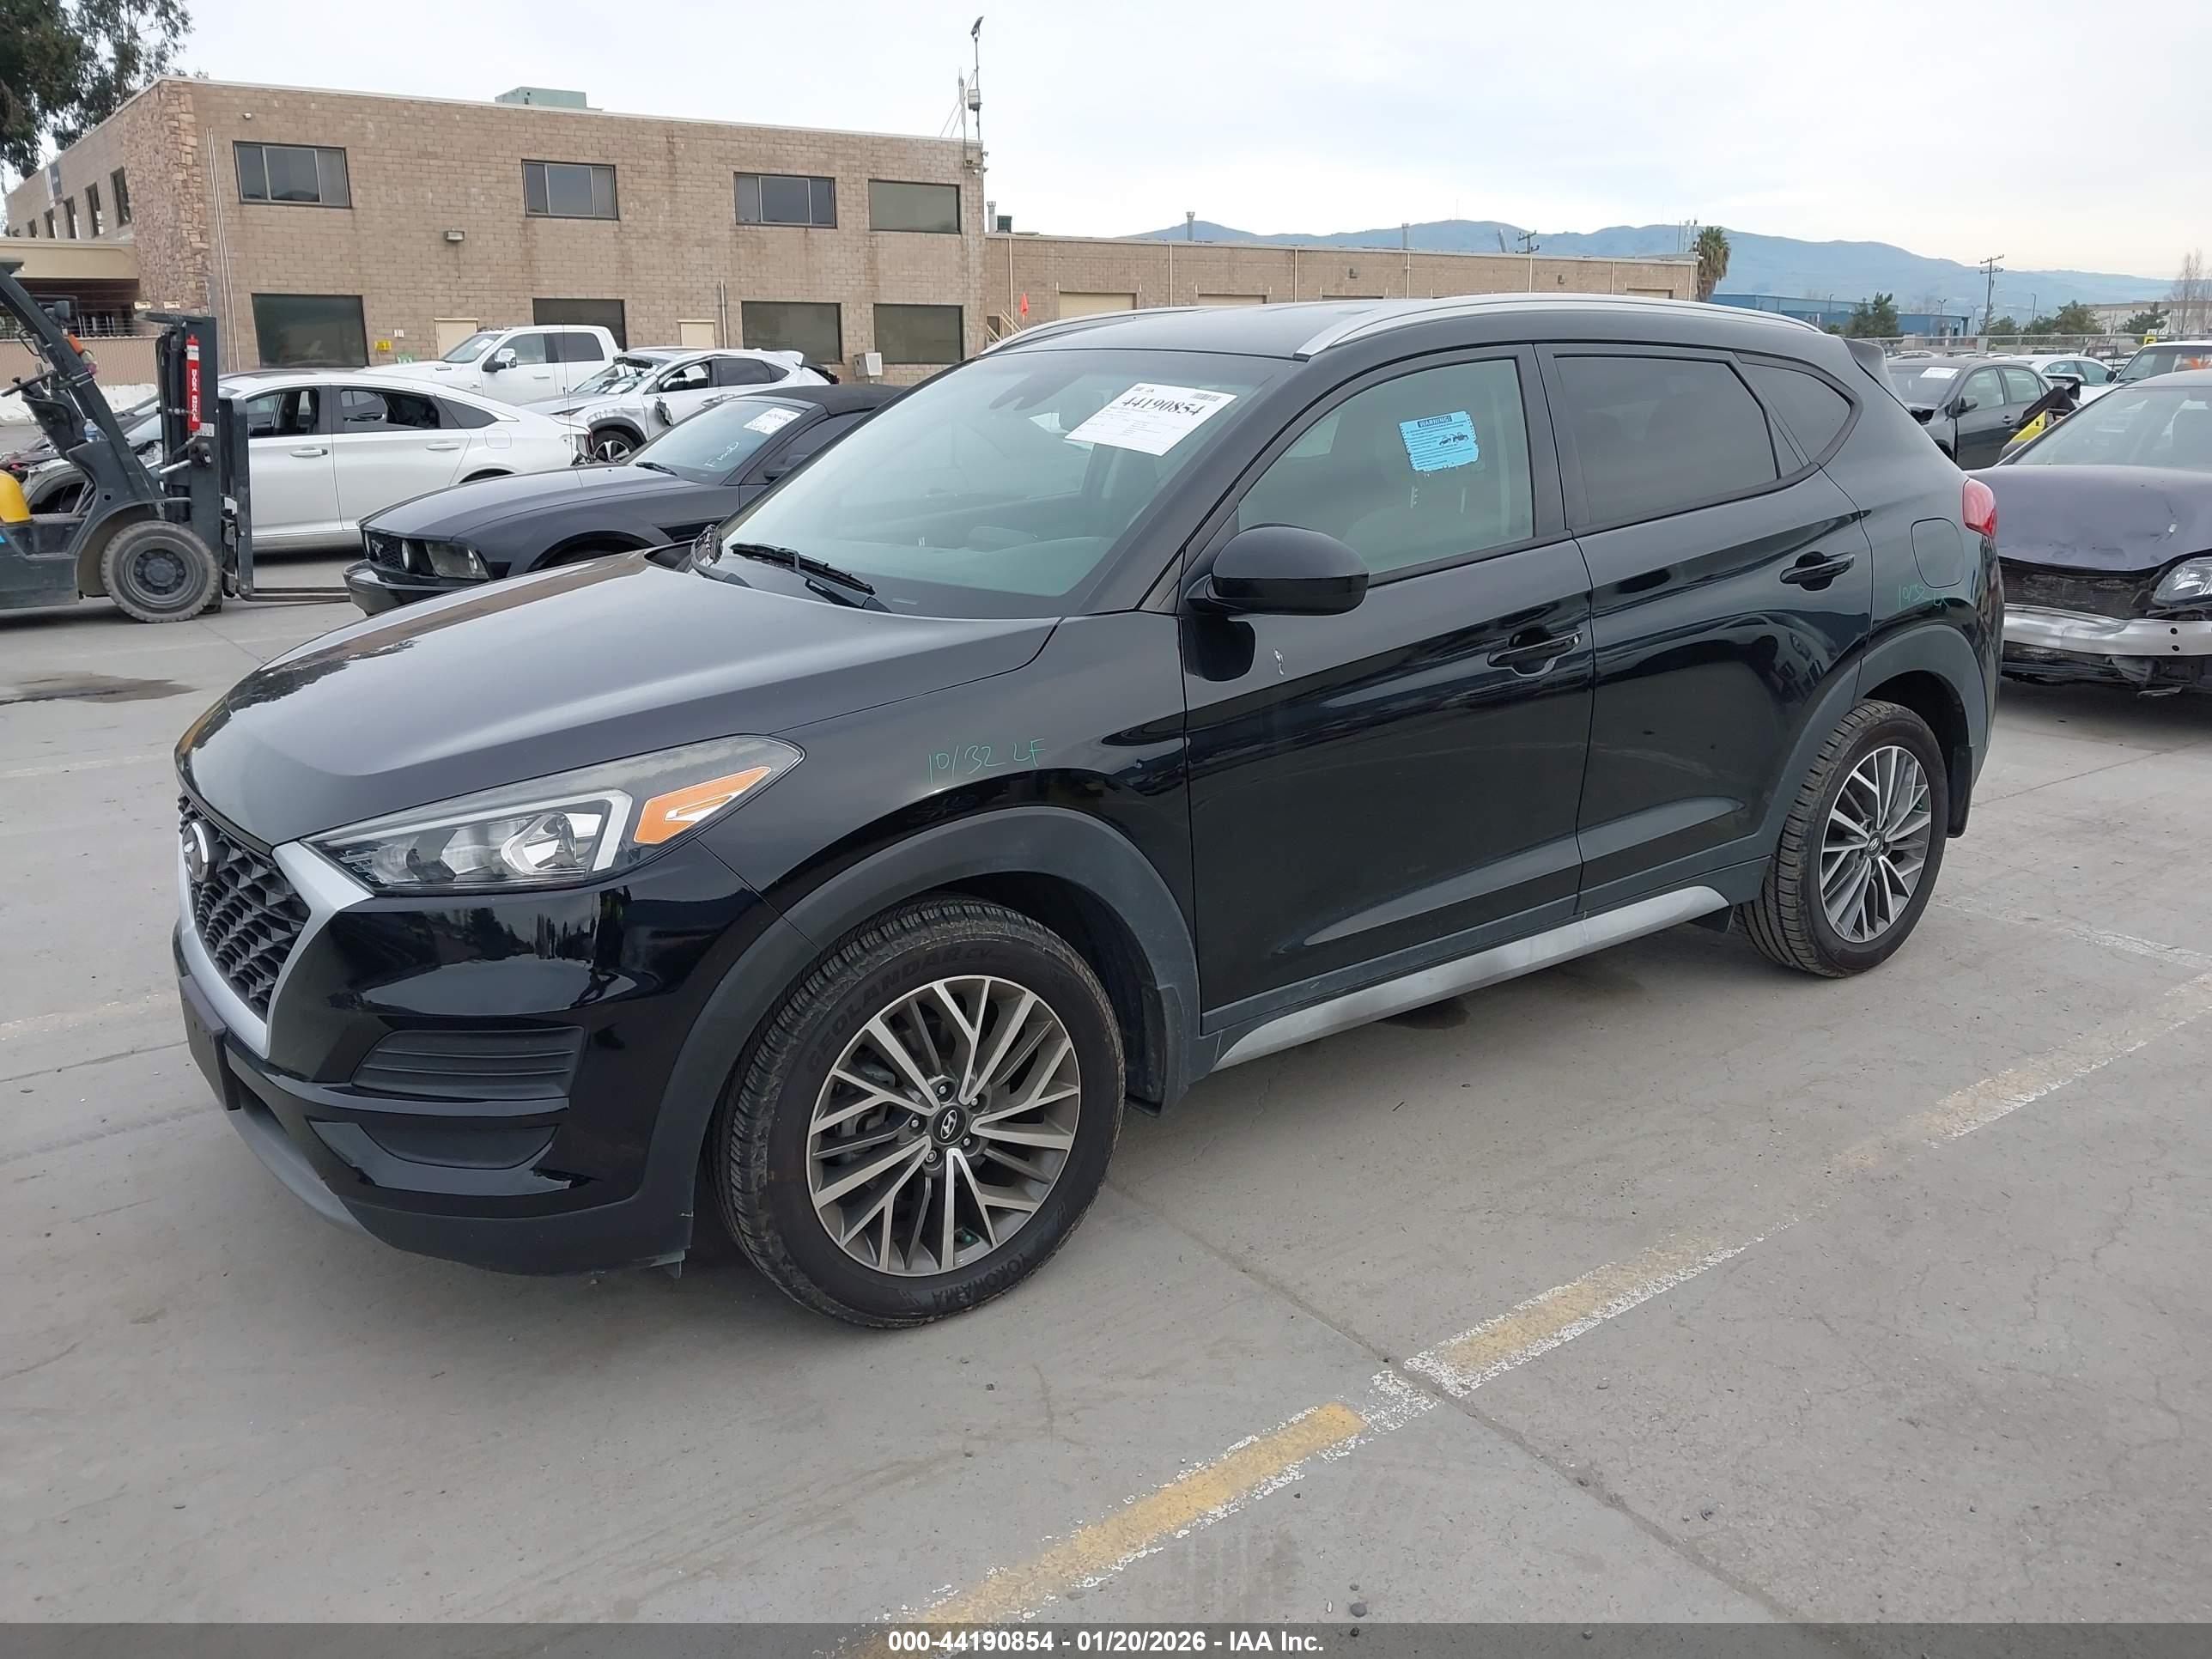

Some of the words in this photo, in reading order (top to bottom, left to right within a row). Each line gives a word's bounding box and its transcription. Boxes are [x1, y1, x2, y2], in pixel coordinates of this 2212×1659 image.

[1121, 396, 1206, 416] 44190854
[1419, 415, 1451, 428] WARNING!
[928, 744, 1006, 785] 10/32
[1013, 738, 1047, 768] LF
[806, 945, 963, 1073] GEOLANDAR
[930, 1254, 1033, 1310] YOKOHAMA
